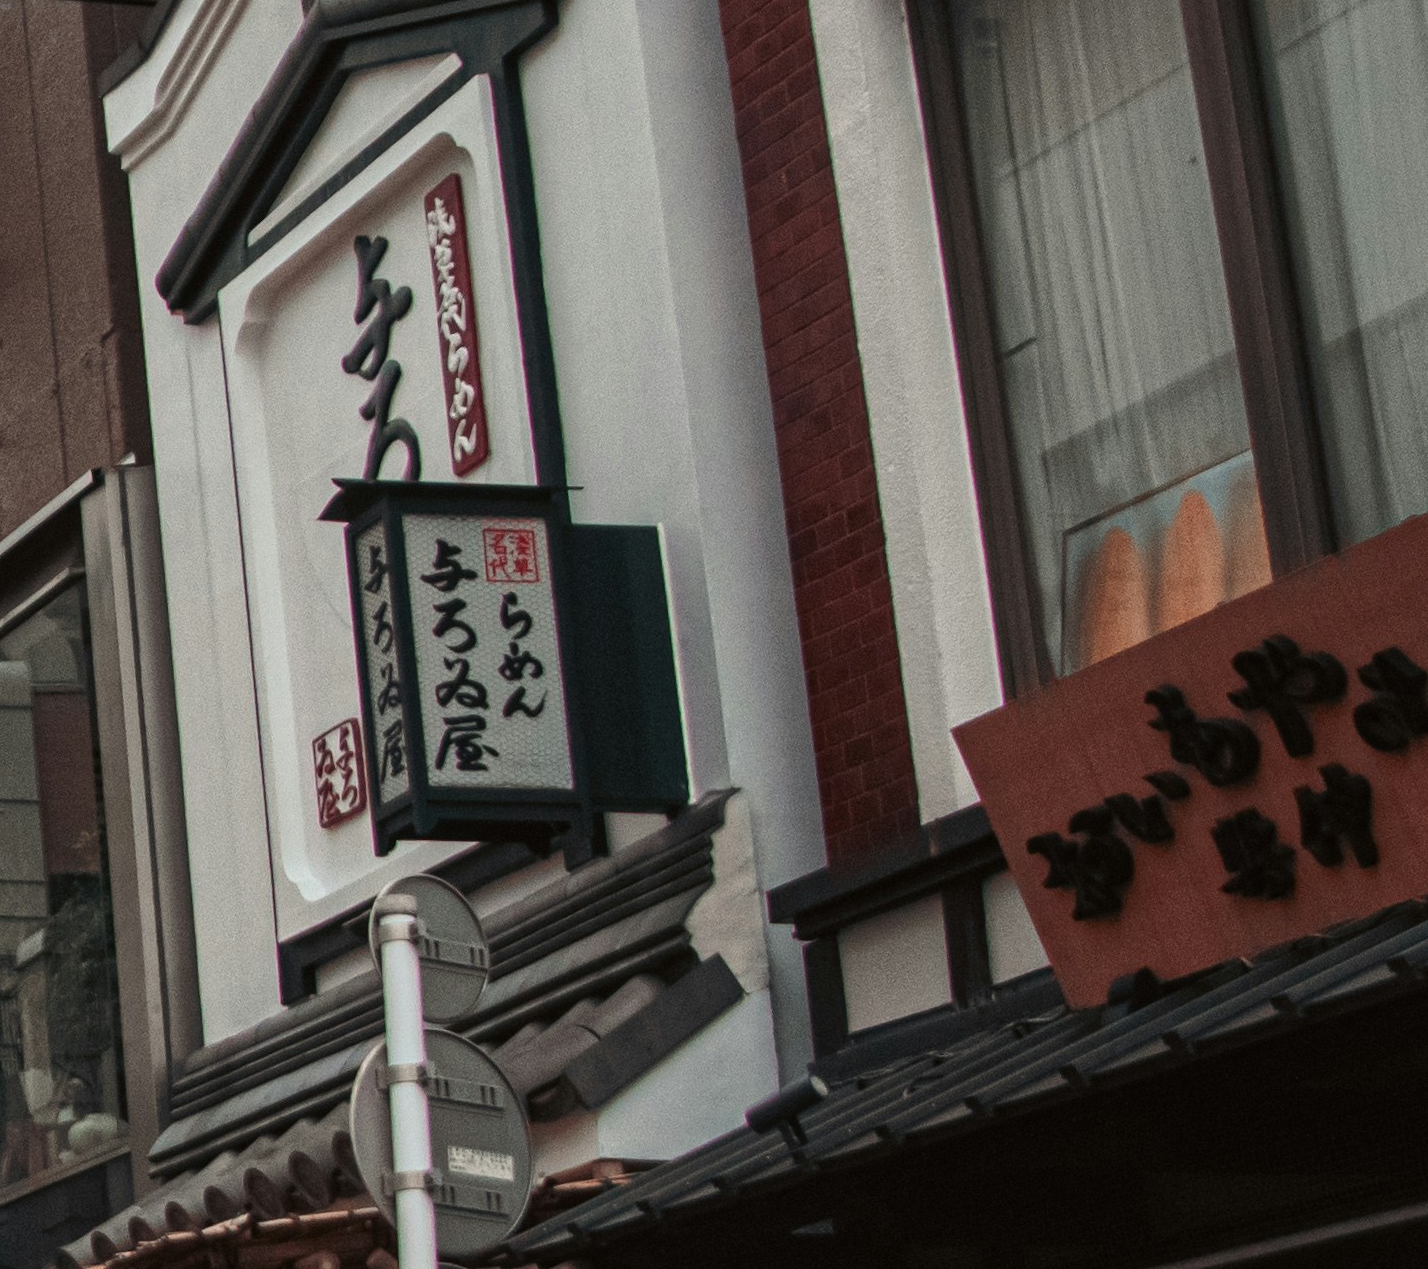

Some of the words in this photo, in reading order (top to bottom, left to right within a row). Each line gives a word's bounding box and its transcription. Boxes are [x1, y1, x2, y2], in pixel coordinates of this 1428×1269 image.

[487, 532, 509, 578] 名代
[421, 538, 500, 771] 与ろゐ屋
